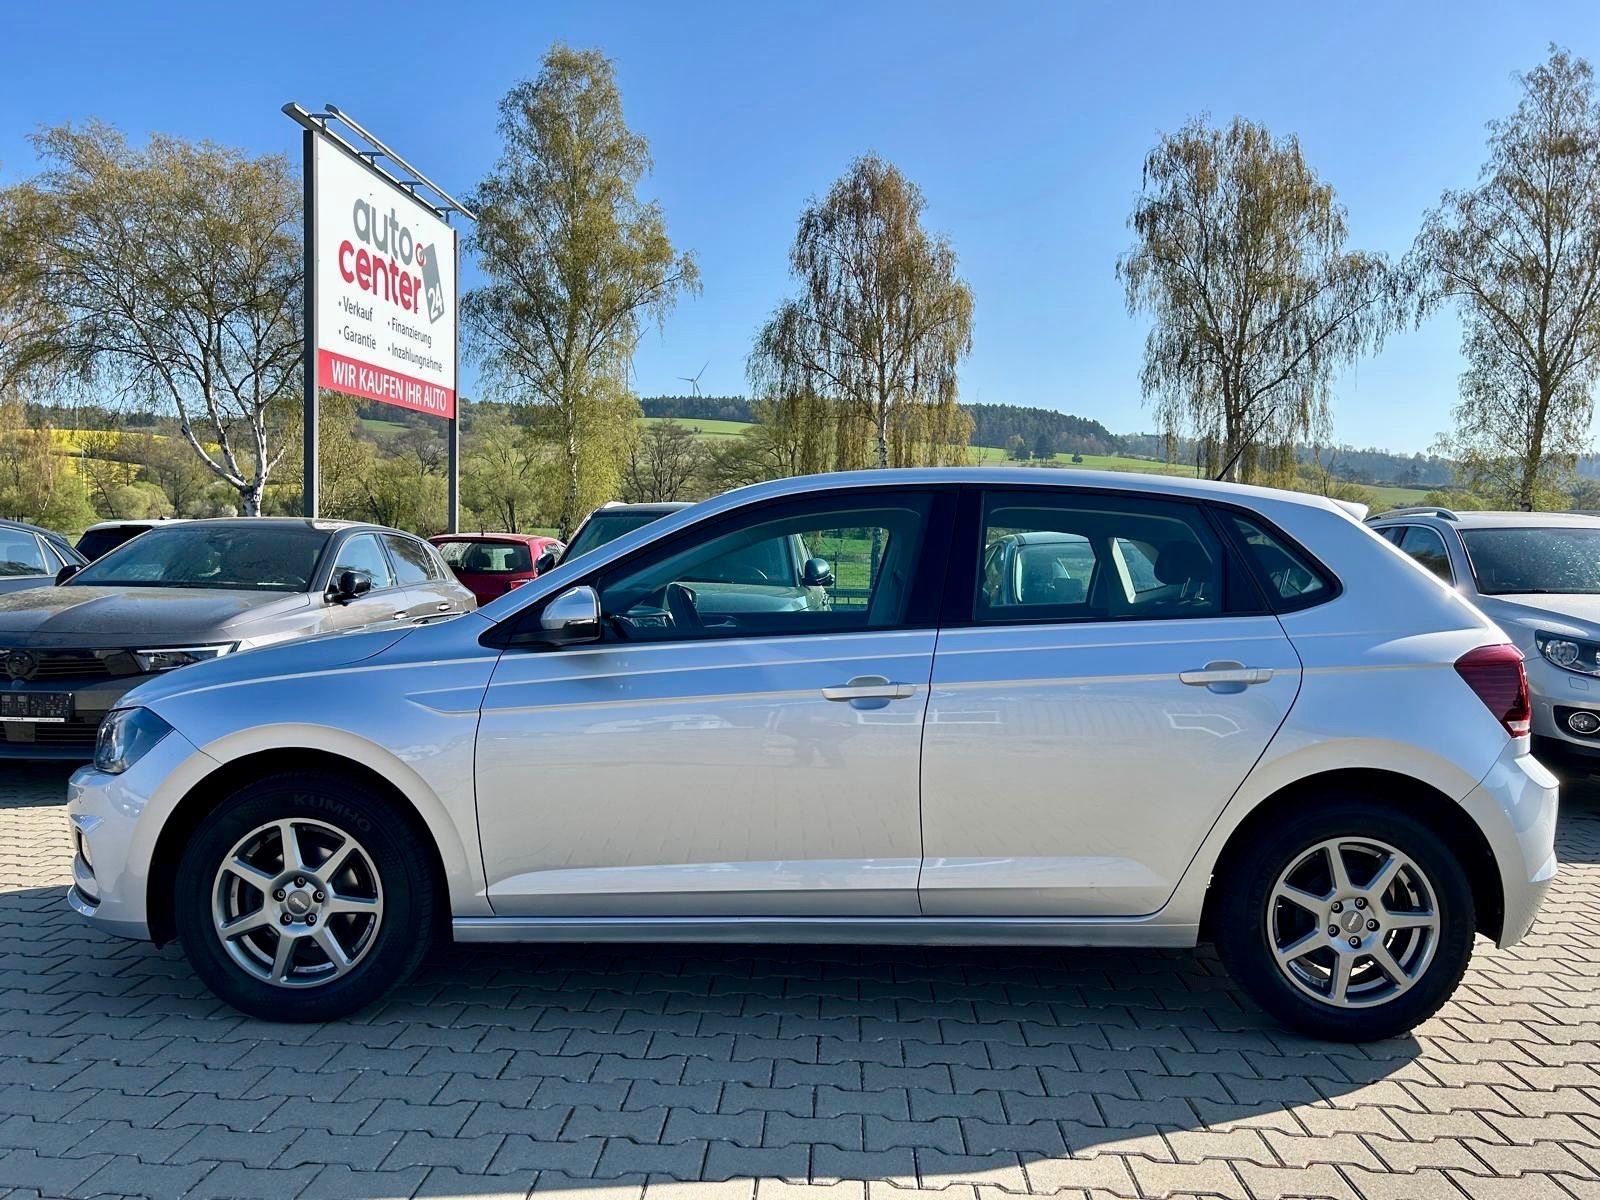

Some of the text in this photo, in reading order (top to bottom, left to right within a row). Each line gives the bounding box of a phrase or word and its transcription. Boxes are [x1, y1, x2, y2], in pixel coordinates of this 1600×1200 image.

[353, 199, 413, 266] auto
[338, 240, 421, 314] center
[343, 296, 373, 322] Verkauf
[427, 284, 443, 321] 24
[343, 325, 376, 350] Garantie
[391, 317, 432, 349] Finanzierung
[391, 342, 443, 373] Inzahlungnahme
[331, 359, 447, 412] WIR KAUFEN IHR AUTO
[292, 793, 373, 833] KUMHO
